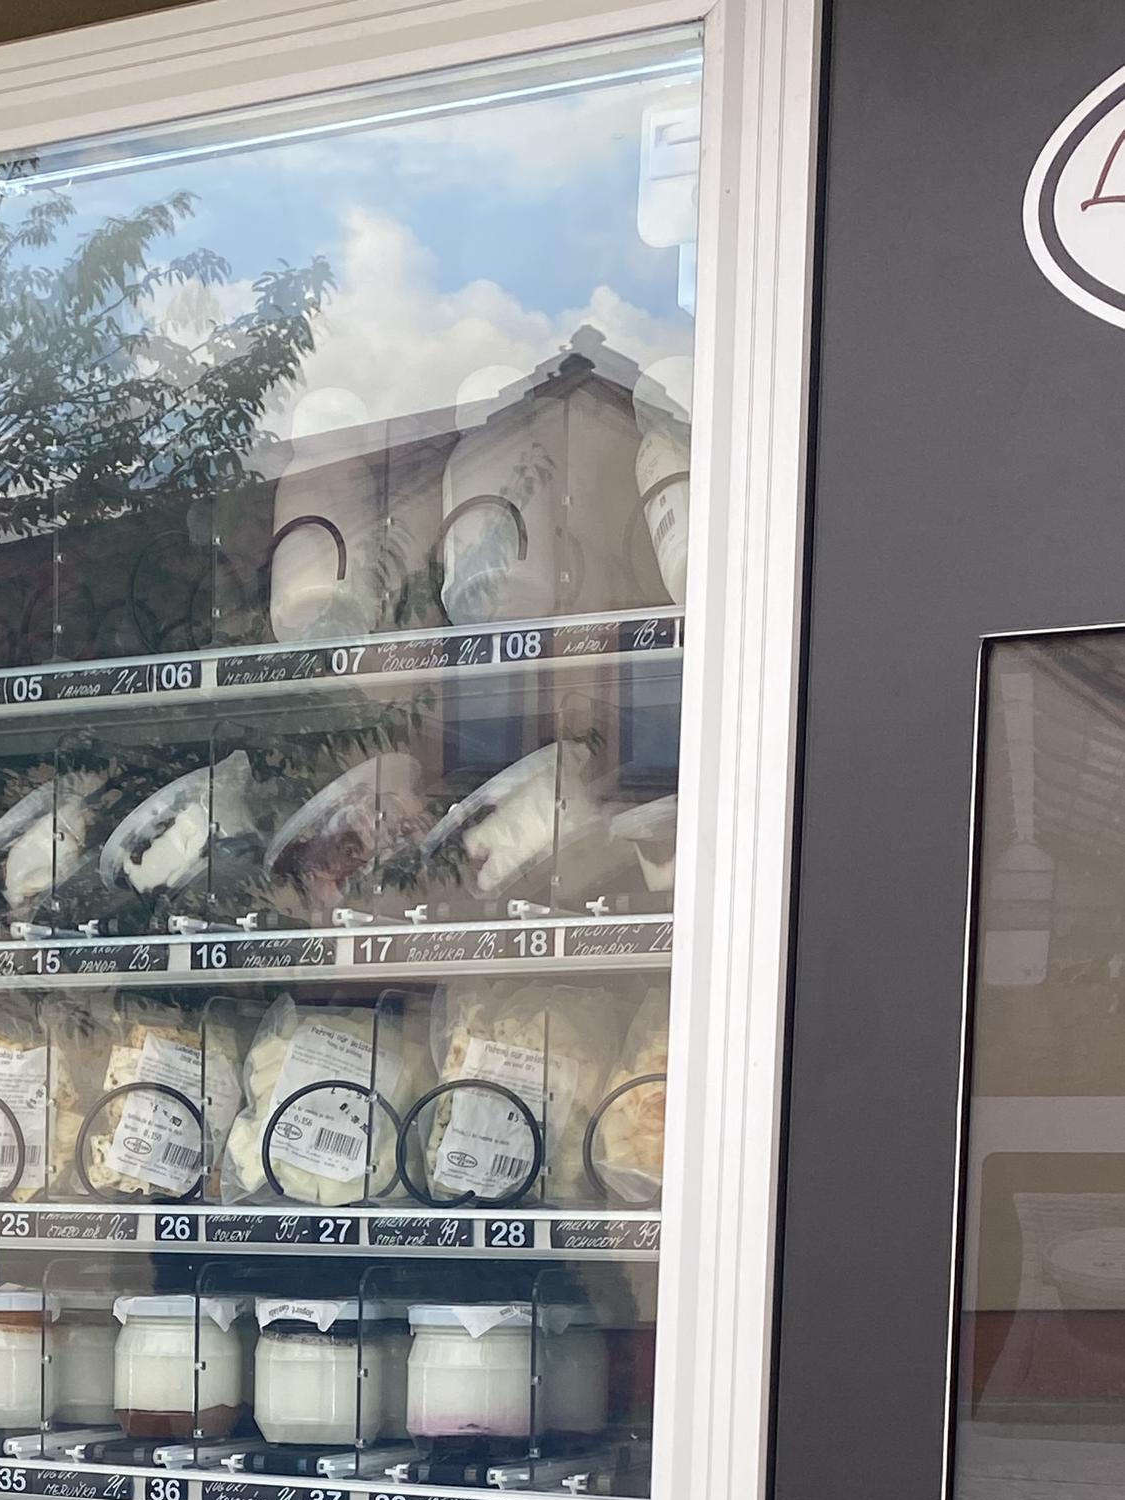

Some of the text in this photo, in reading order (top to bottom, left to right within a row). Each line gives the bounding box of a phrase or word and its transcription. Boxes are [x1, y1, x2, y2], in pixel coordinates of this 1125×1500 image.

[505, 630, 542, 660] 08
[563, 634, 609, 655] NÁPOJ
[331, 647, 367, 675] 07
[13, 675, 43, 702] 05
[161, 663, 193, 690] 06
[57, 683, 101, 698] JAHODA
[196, 942, 228, 968] 16
[360, 935, 394, 963] 17
[406, 943, 466, 963] BORŮVKA
[513, 929, 548, 957] 18
[31, 949, 61, 974] 15
[79, 959, 117, 973] PANDA
[242, 955, 292, 968] MALINA
[1, 1213, 30, 1236] 25
[160, 1215, 191, 1241] 26
[318, 1218, 352, 1243] 27
[490, 1220, 526, 1246] 28
[43, 1481, 97, 1498] MERUŇKA
